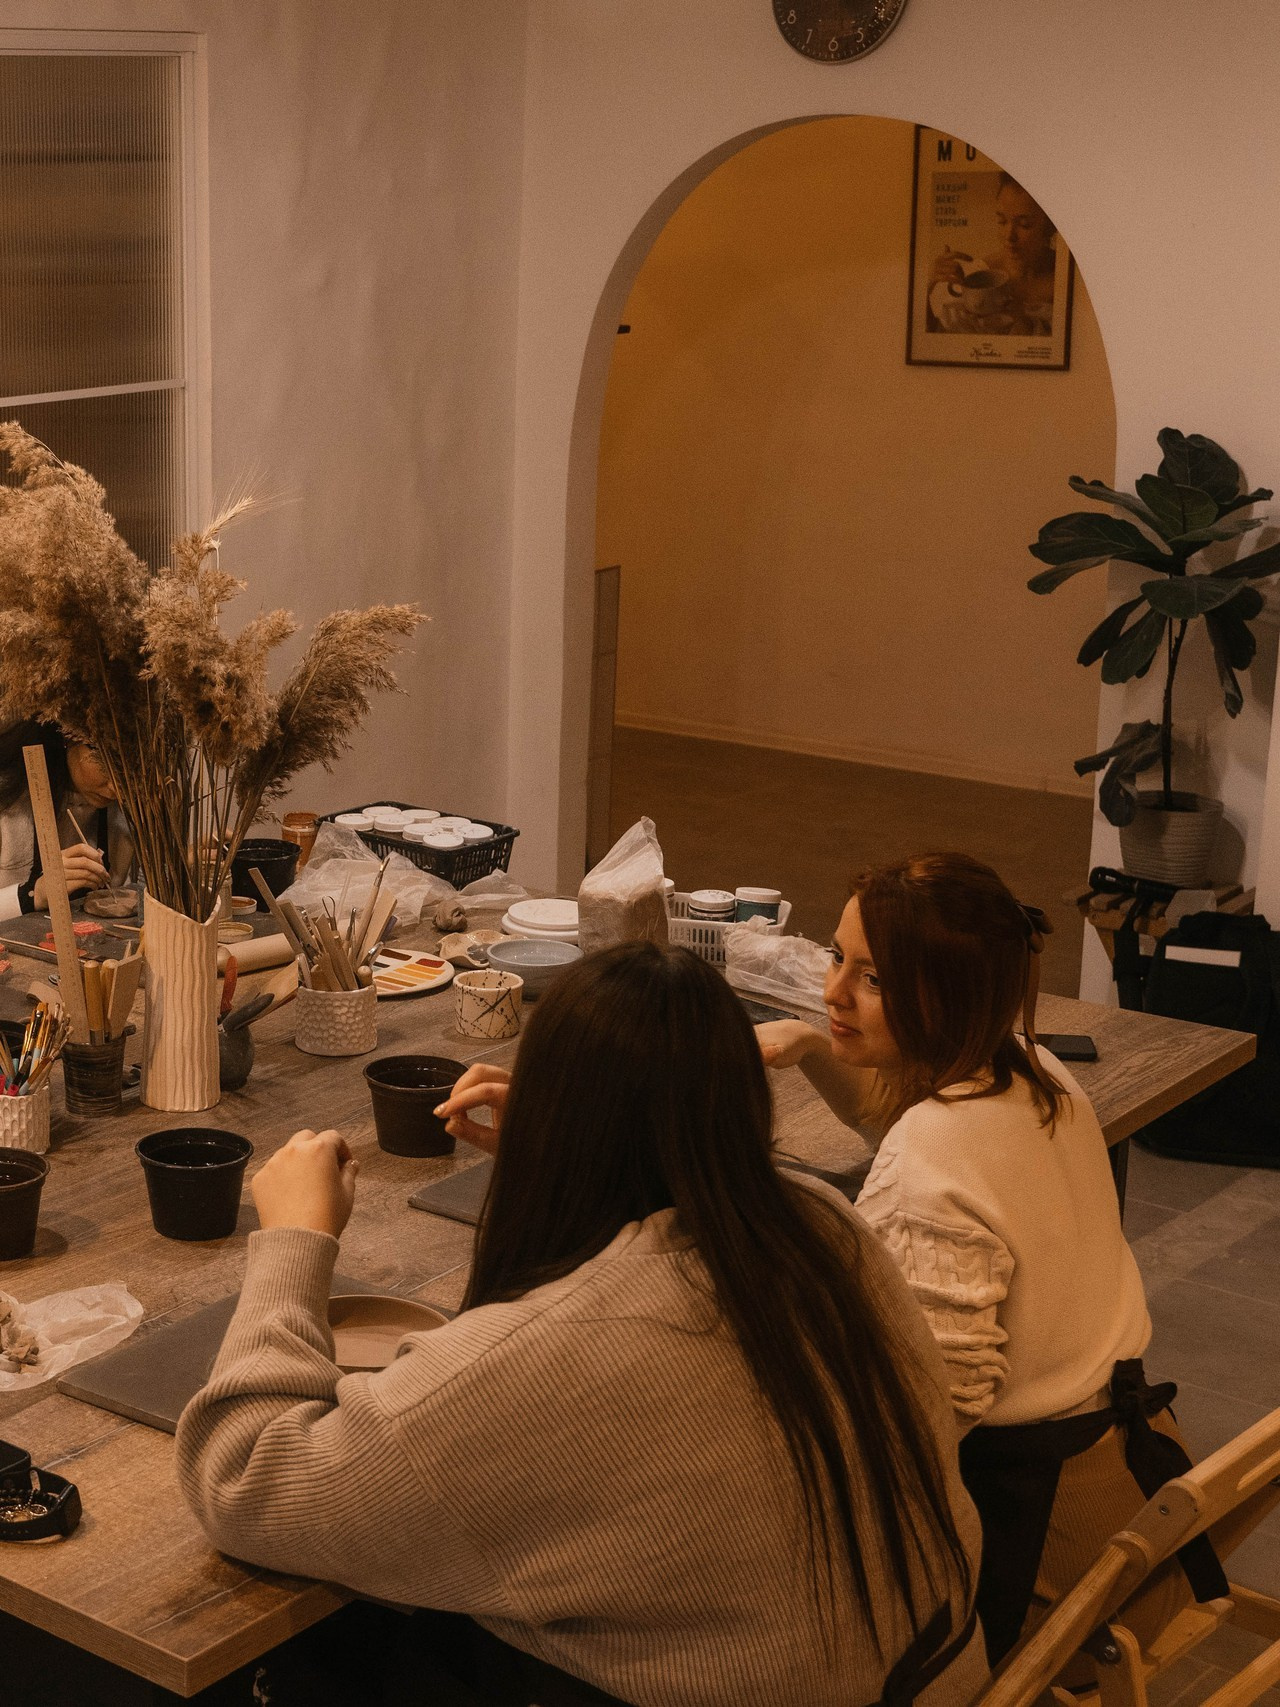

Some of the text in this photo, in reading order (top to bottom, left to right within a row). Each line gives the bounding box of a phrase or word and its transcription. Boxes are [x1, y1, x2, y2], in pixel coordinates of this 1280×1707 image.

[787, 9, 797, 25] 8
[806, 29, 813, 44] 7
[856, 27, 864, 43] 5
[828, 37, 839, 52] 6
